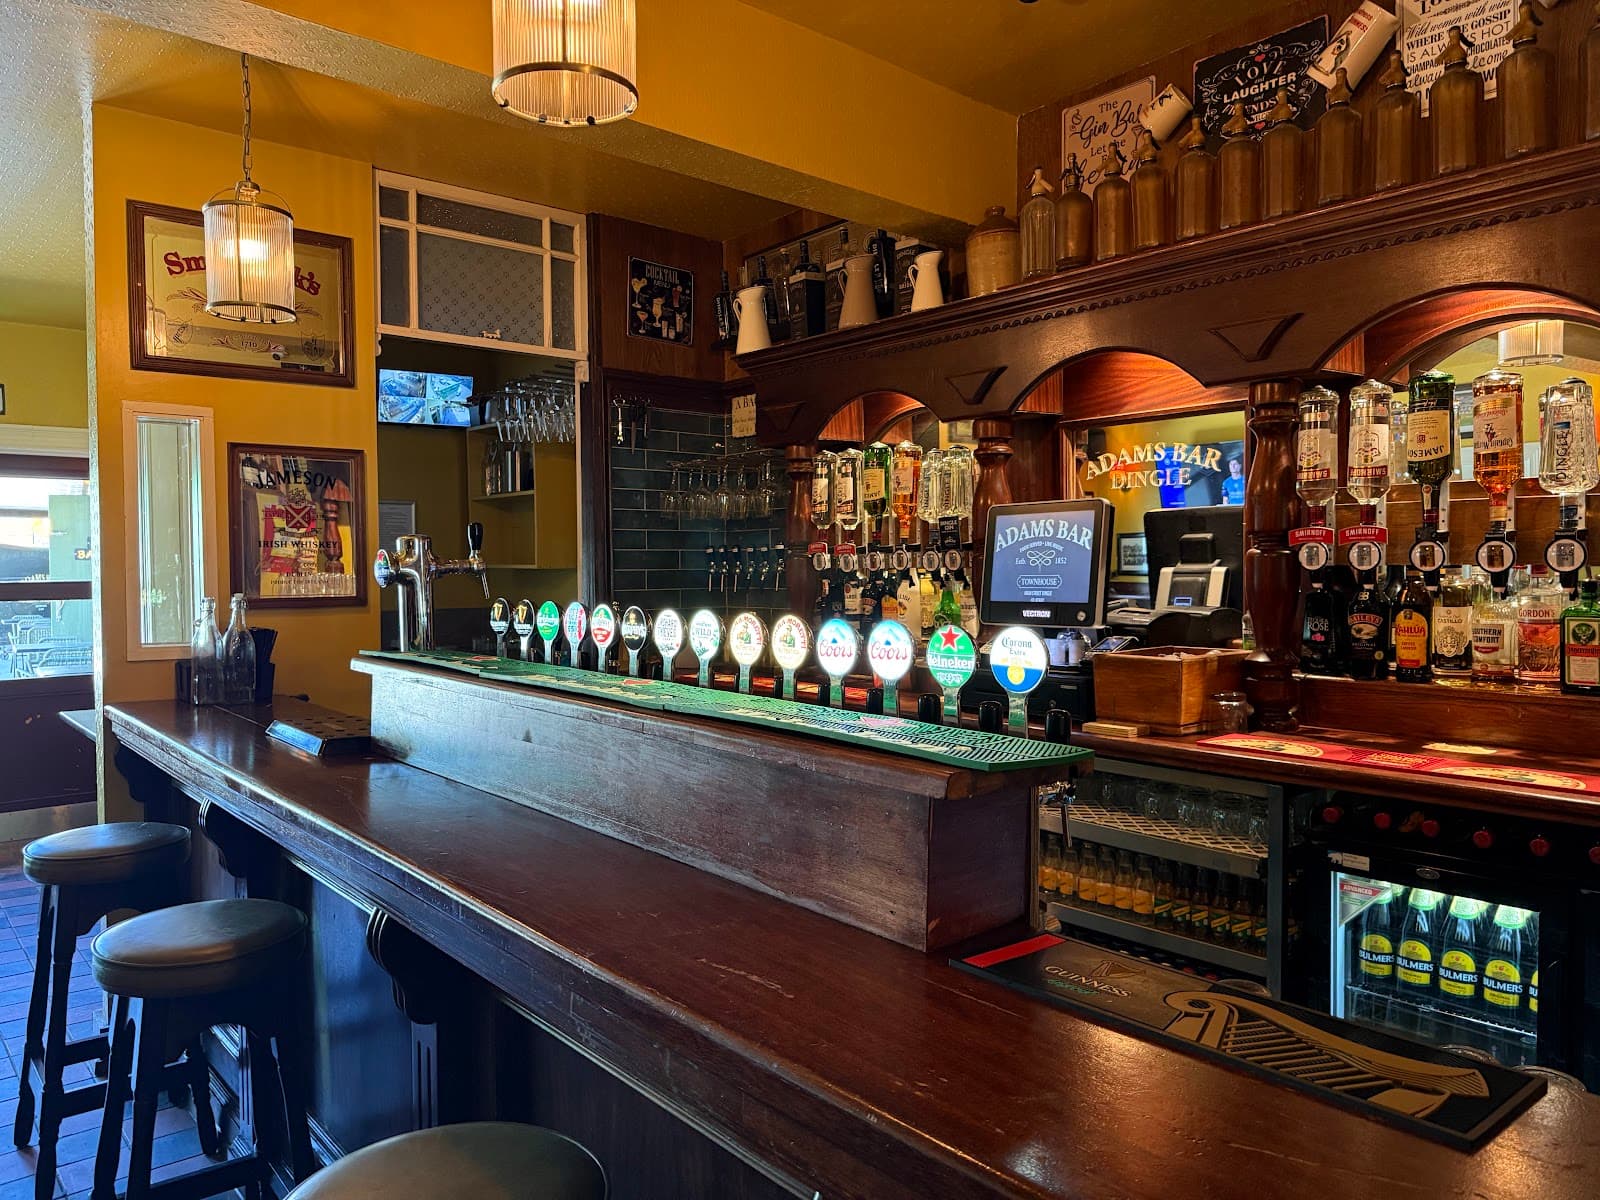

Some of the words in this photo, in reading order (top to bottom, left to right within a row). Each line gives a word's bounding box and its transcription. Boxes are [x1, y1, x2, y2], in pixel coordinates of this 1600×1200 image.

[1406, 22, 1431, 40] Wild
[1430, 17, 1462, 33] women
[1464, 5, 1486, 21] with
[1406, 31, 1445, 51] WHERE
[1470, 9, 1511, 30] GOSSIP
[1481, 20, 1511, 40] HOT
[1234, 60, 1287, 87] LOVE
[1223, 71, 1297, 104] LAUGHTER
[1098, 100, 1119, 114] The
[1070, 115, 1109, 149] Gin
[1090, 145, 1107, 157] Let
[645, 263, 680, 284] COCKTAIL
[1407, 444, 1445, 459] JAMESO
[1489, 437, 1514, 451] Captain
[1086, 441, 1167, 481] ADAMS
[1171, 442, 1223, 472] BAR
[1554, 430, 1571, 481] DINGLE
[256, 470, 338, 491] JAMESON
[1111, 466, 1192, 490] DINGLE
[995, 519, 1054, 552] ADAMS
[1056, 520, 1092, 550] BAR
[1295, 528, 1326, 538] SMIRNOFF
[1345, 527, 1380, 537] SMIRNOFF
[258, 540, 287, 548] IRISH
[291, 540, 338, 549] WHISKEY
[1021, 578, 1058, 586] TOWNHOUSE
[1437, 617, 1463, 625] CASTILLO
[1518, 607, 1556, 619] GORDON'S
[1308, 621, 1329, 631] ROSE
[819, 640, 854, 659] Coors
[871, 640, 908, 661] Coors
[1001, 637, 1033, 650] Corona
[1358, 949, 1395, 963] BULMERS
[1397, 957, 1434, 973] BULMERS
[1044, 966, 1132, 998] GUINNESS
[1439, 968, 1478, 984] BULMERS
[1483, 975, 1524, 994] BULMERS
